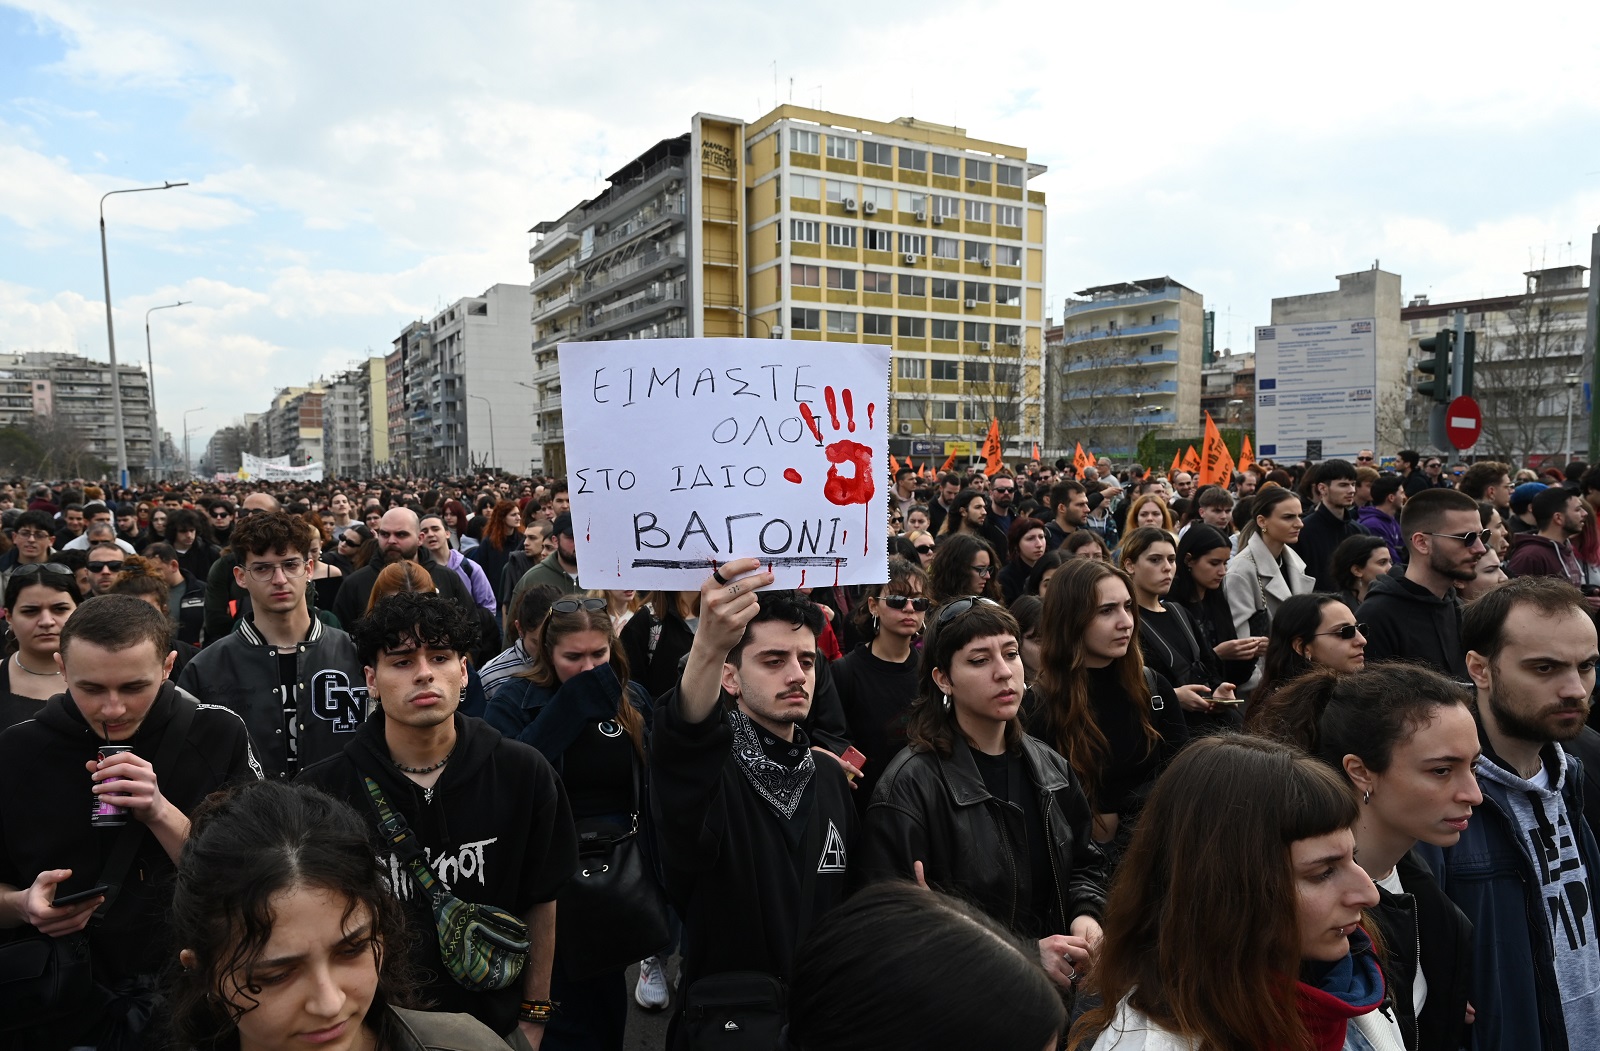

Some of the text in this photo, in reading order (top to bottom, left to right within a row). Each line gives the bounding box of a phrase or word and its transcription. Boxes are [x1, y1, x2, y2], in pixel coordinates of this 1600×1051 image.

[594, 365, 816, 407] ΕΙΜΑΣΤΕ
[712, 415, 824, 447] ΟΛΟΙ
[575, 464, 767, 494] ΣΤΟ ΙΔΙΟ
[633, 511, 841, 555] ΒΑΓΟΝΙ
